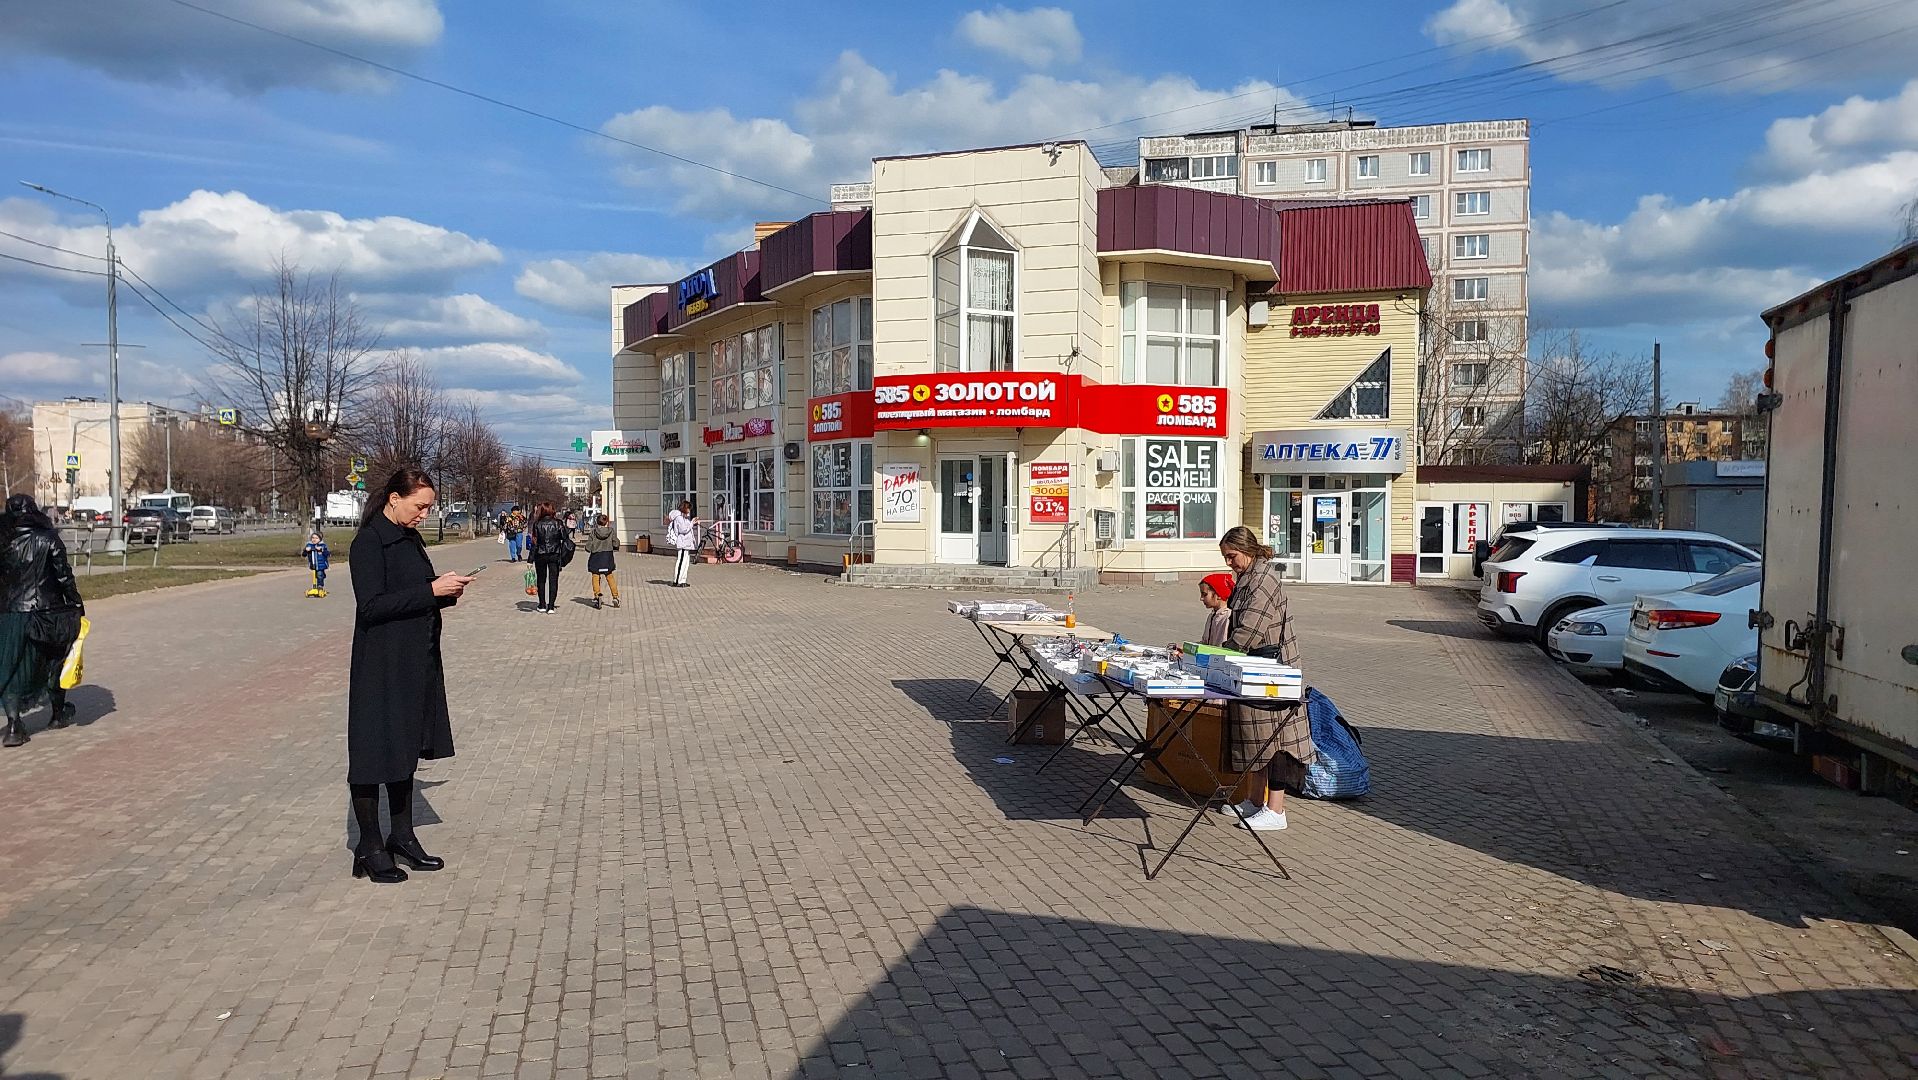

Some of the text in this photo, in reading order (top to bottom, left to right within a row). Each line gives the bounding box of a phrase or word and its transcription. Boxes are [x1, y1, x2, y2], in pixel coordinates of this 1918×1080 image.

[1291, 304, 1380, 325] АРЕНДА
[875, 379, 1056, 403] 585 ЗОЛОТОЙ
[821, 402, 842, 420] 585
[937, 408, 986, 417] магазин
[996, 406, 1050, 417] ломбард
[1178, 395, 1216, 413] 585
[813, 420, 842, 433] ЗОЛОТОЙ
[1156, 415, 1216, 428] ЛОМБАРД
[1148, 444, 1211, 468] SALE
[1263, 437, 1394, 459] АПТЕКА 71
[817, 448, 846, 470] SALE
[1148, 471, 1211, 487] ОБМЕН
[1147, 492, 1212, 504] РАССРОЧКА
[1467, 503, 1478, 551] АРЕНДА
